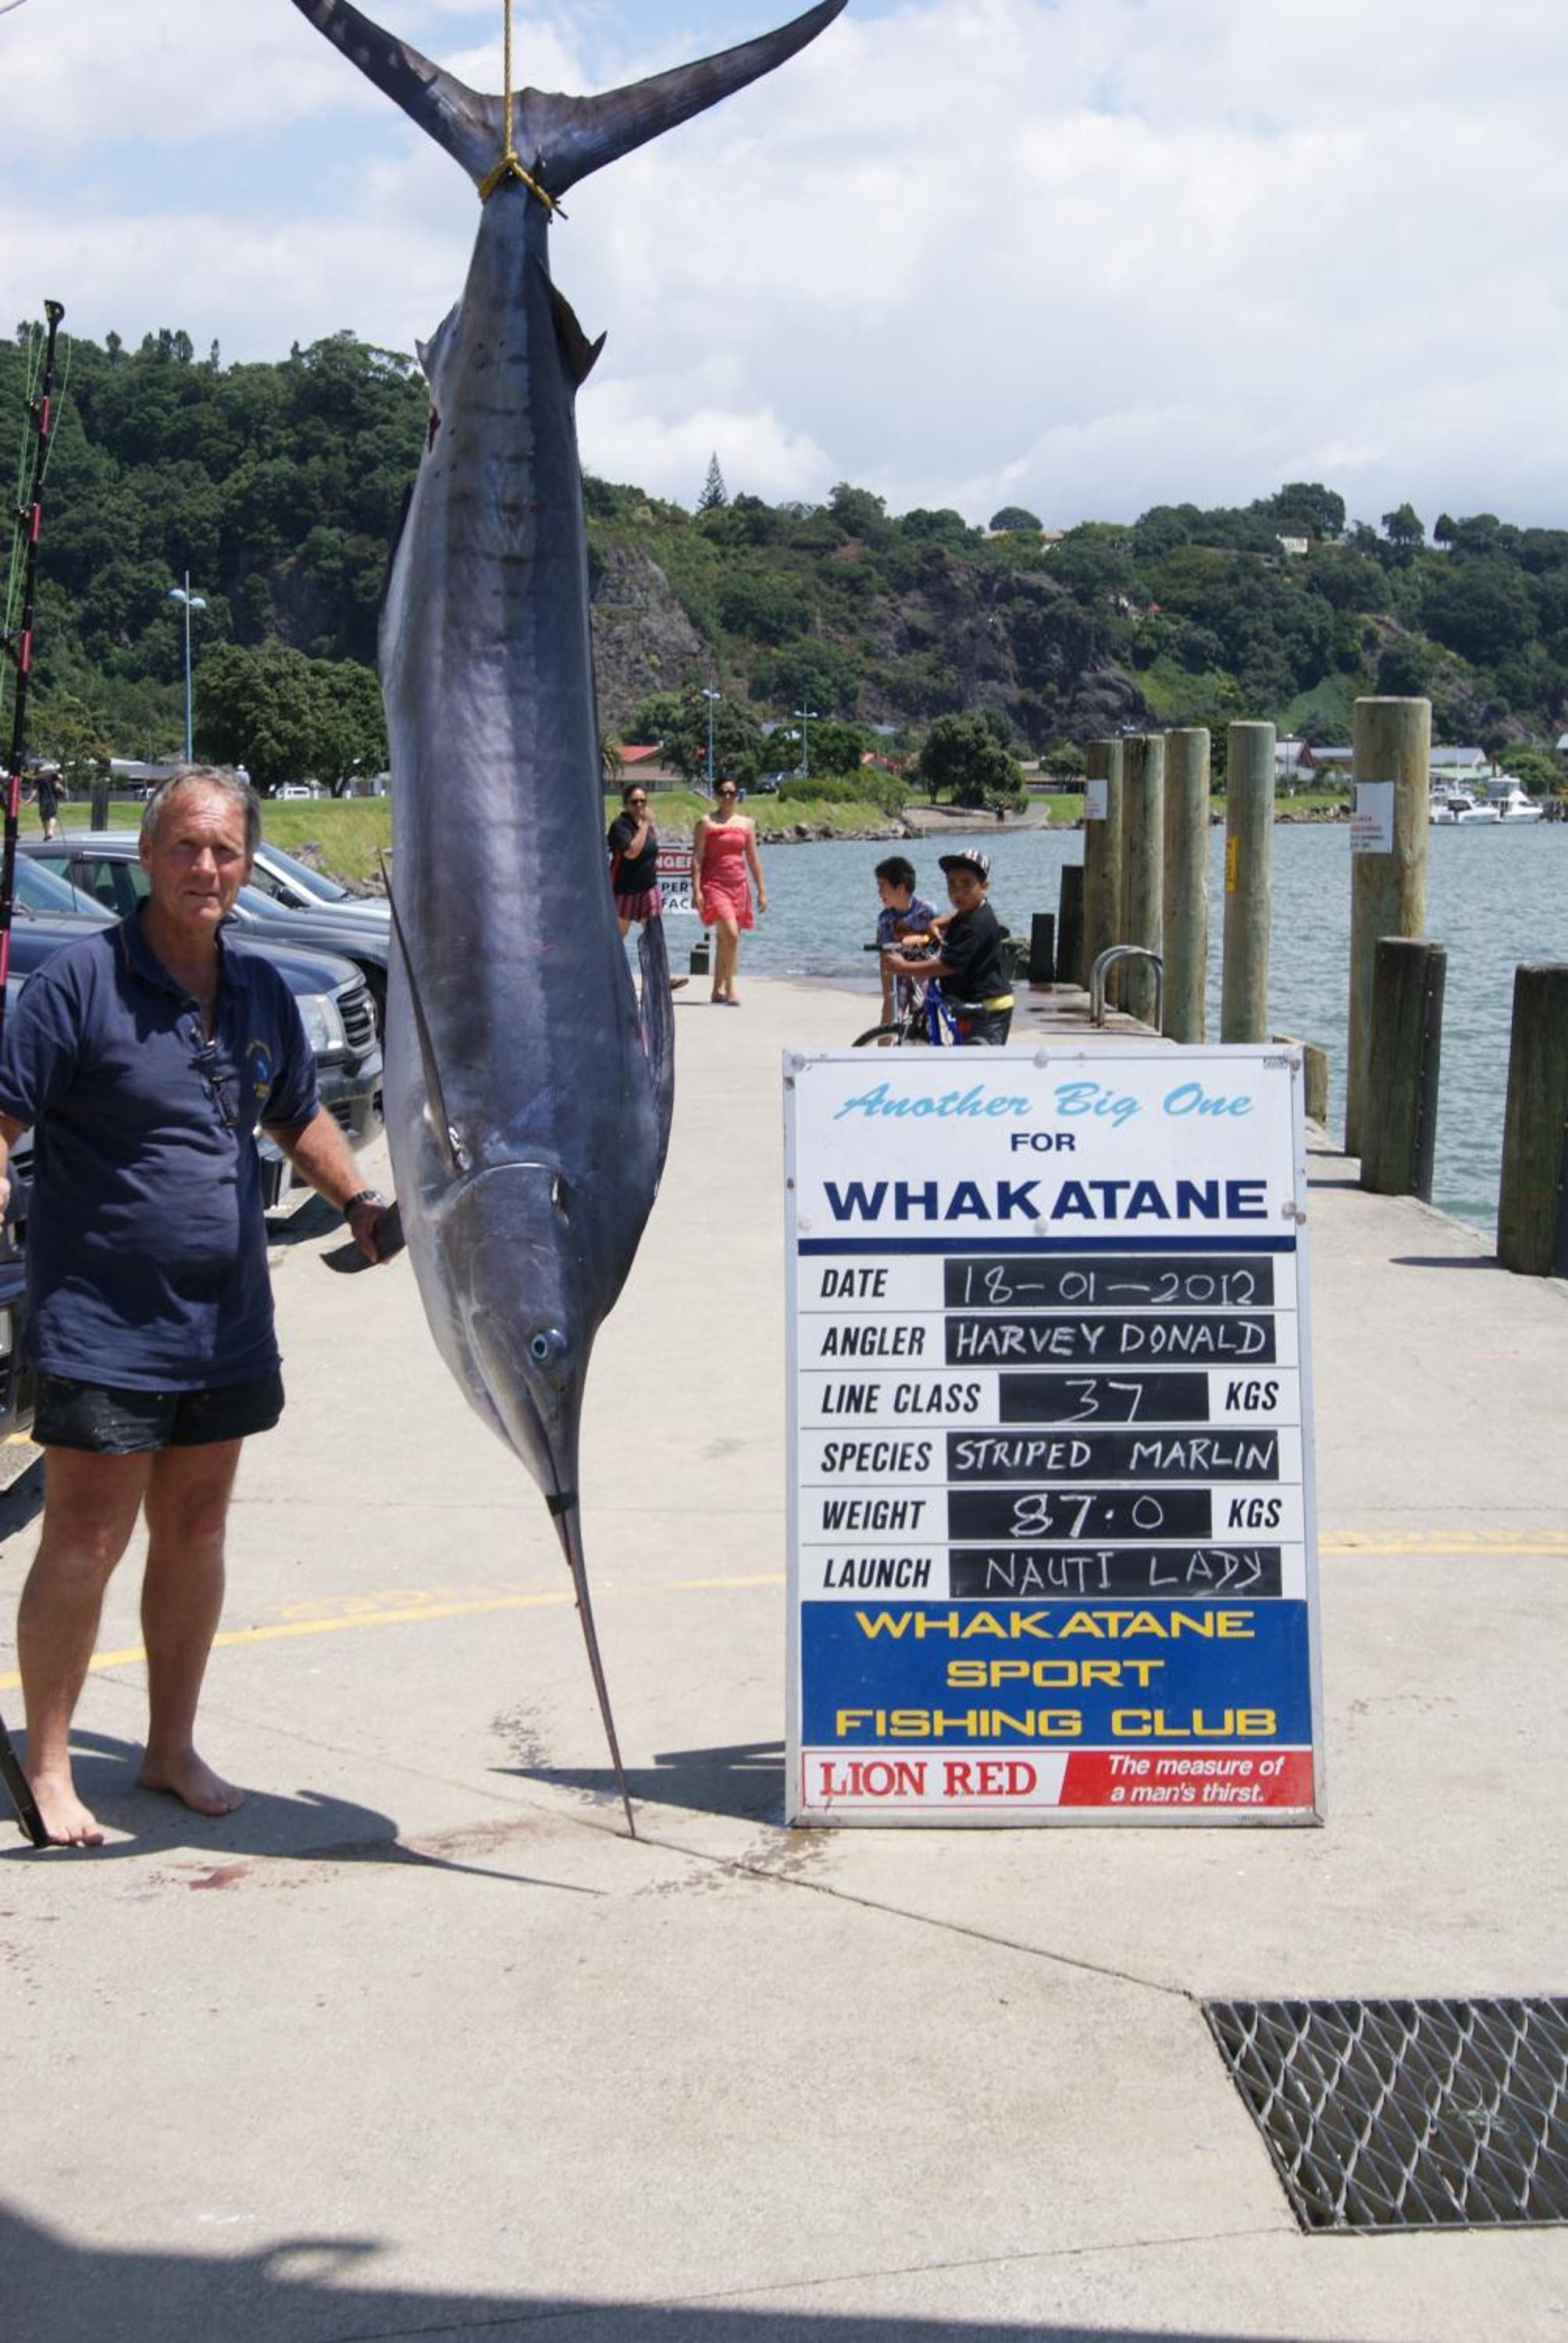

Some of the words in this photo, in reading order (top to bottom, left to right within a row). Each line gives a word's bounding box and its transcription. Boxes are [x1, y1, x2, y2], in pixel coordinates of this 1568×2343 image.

[834, 1083, 1028, 1119] Another
[1054, 1082, 1140, 1127] Big
[1164, 1082, 1250, 1116] One
[1011, 1133, 1074, 1151] FOR
[824, 1181, 1267, 1220] WHAKATANE
[821, 1269, 888, 1297] DATE
[821, 1327, 925, 1356] ANGLER
[957, 1324, 1104, 1357] HARVEY
[1121, 1321, 1265, 1354] DONALD
[821, 1385, 880, 1413] LINE
[894, 1384, 981, 1413] CLASS
[1057, 1380, 1142, 1422] 37
[1226, 1382, 1278, 1410] KGS
[821, 1443, 932, 1472] SPECIES
[956, 1439, 1090, 1469] STRIPED
[1130, 1439, 1274, 1470] MARLIN
[823, 1500, 925, 1529] WEIGHT
[1228, 1499, 1281, 1528] KGS
[824, 1559, 931, 1588] LAUNCH
[986, 1551, 1114, 1596] NAUTI
[1149, 1550, 1261, 1589] LADY
[856, 1611, 1254, 1638] WHAKATANE
[947, 1660, 1164, 1687] SPORT
[836, 1710, 1082, 1736] FISHING
[1112, 1710, 1276, 1735] CLUB
[820, 1762, 927, 1796] LION
[943, 1762, 1036, 1796] RED
[1109, 1755, 1150, 1775] The
[1156, 1758, 1253, 1775] measure
[1260, 1756, 1285, 1775] of
[1110, 1786, 1125, 1802] a
[1131, 1783, 1196, 1802] man's
[1203, 1783, 1263, 1802] thirst.
